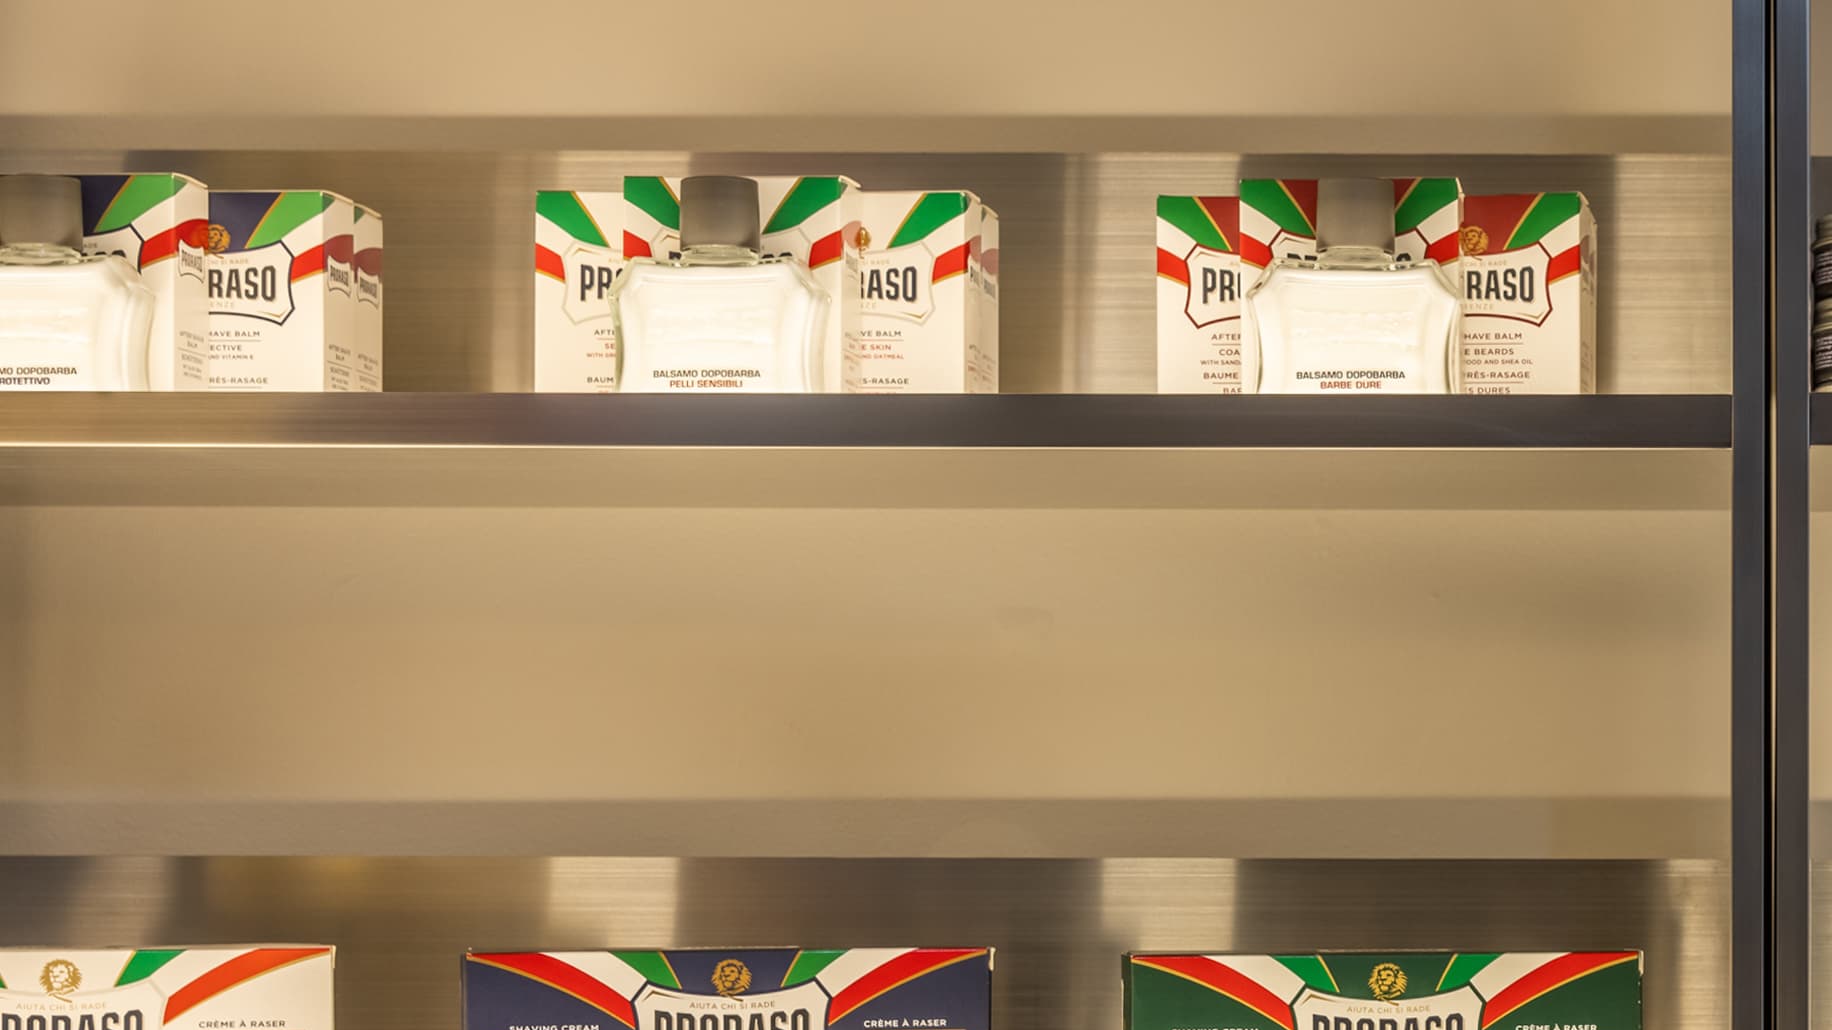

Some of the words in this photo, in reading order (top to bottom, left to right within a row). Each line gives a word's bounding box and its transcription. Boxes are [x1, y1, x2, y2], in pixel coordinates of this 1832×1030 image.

[1466, 266, 1534, 303] RASO
[1494, 332, 1522, 340] BALM
[1473, 348, 1514, 356] BEARDS
[16, 367, 77, 376] DOPOBARBA
[653, 369, 698, 378] BALSAMO
[702, 369, 761, 378] DOPOBARBA
[1296, 372, 1342, 380] BALSAMO
[1346, 371, 1406, 380] DOPOBARBA
[1203, 373, 1239, 382] BAUME
[669, 380, 694, 389] PELLI
[697, 380, 743, 388] SENSIBILI
[1319, 381, 1351, 390] BARBE
[1355, 381, 1381, 389] DURE
[250, 1020, 286, 1028] RASER
[864, 1018, 900, 1028] CRÈME
[913, 1019, 947, 1028] RASER
